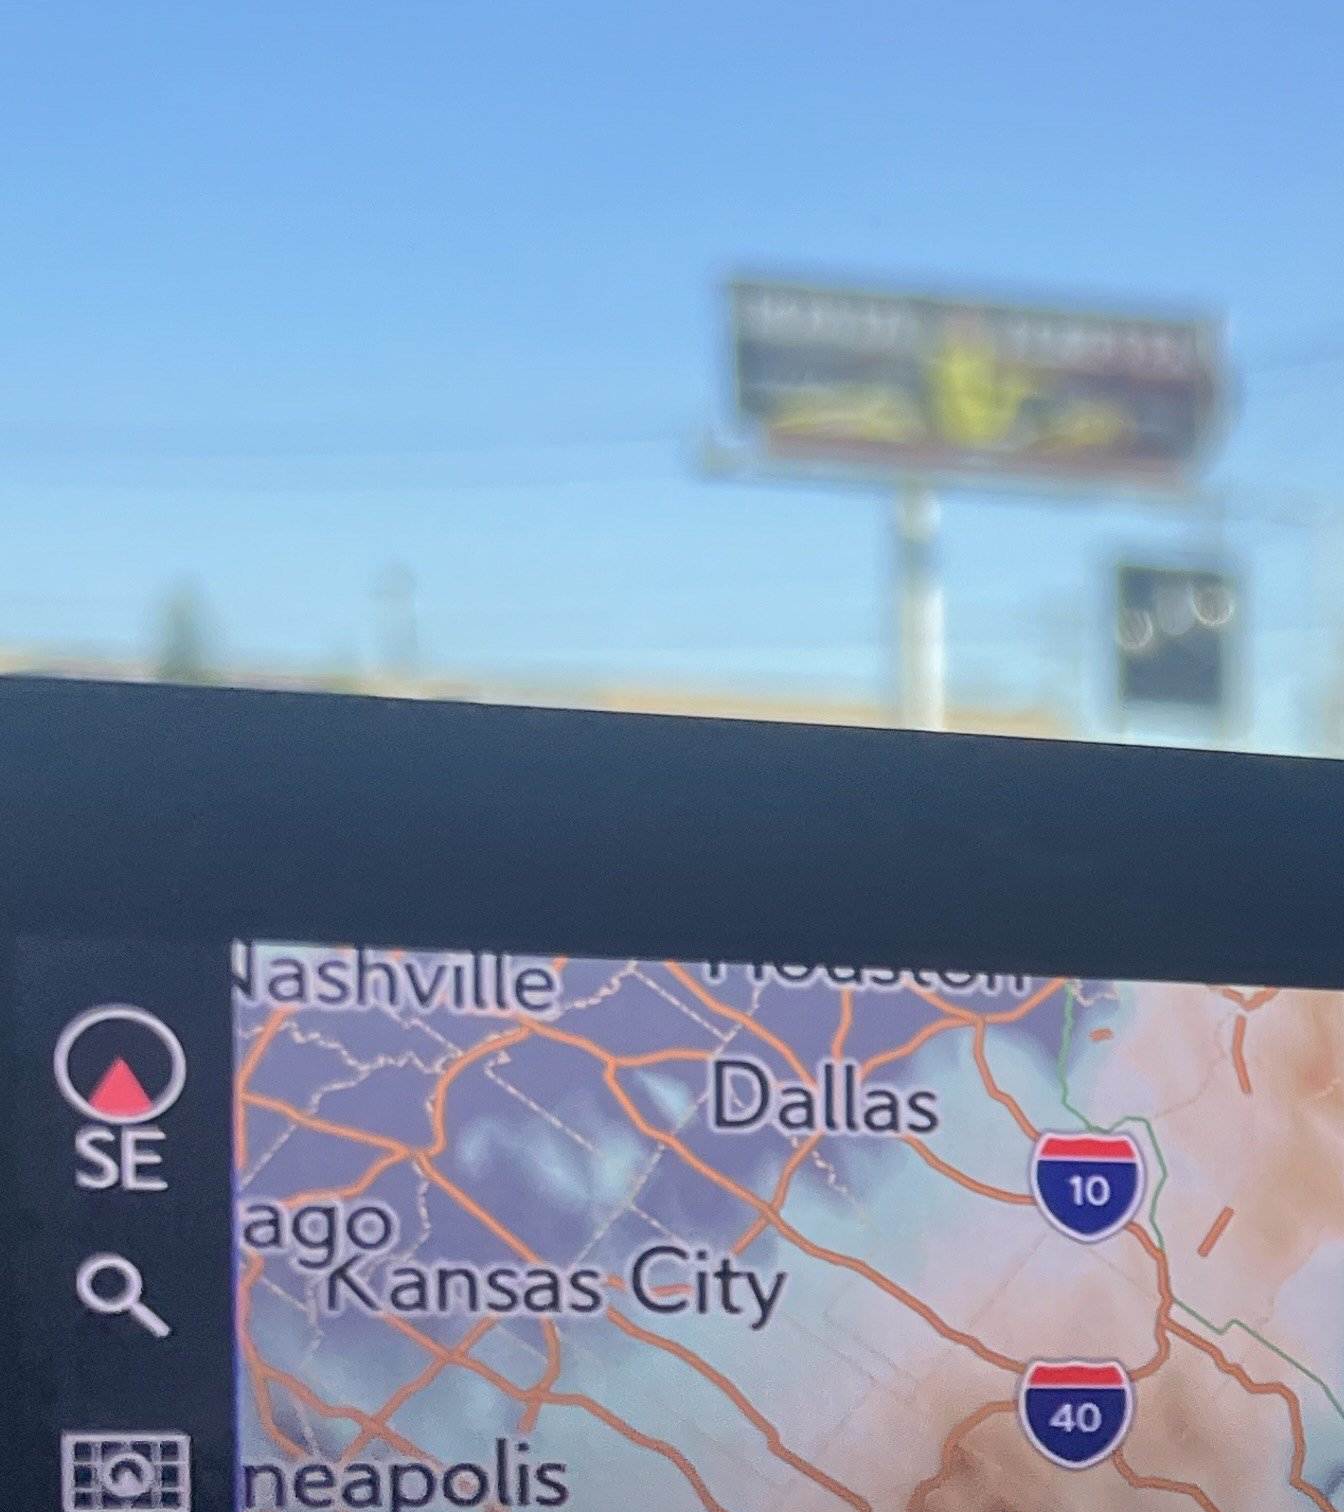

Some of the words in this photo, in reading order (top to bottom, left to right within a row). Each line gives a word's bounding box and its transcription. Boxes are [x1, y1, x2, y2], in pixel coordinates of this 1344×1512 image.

[713, 1060, 941, 1134] Dallas
[74, 1127, 168, 1191] SE
[1070, 1175, 1110, 1208] 10
[243, 1204, 392, 1269] ago
[325, 1252, 602, 1314] Kansas
[632, 1246, 787, 1330] City
[1049, 1402, 1101, 1435] 40
